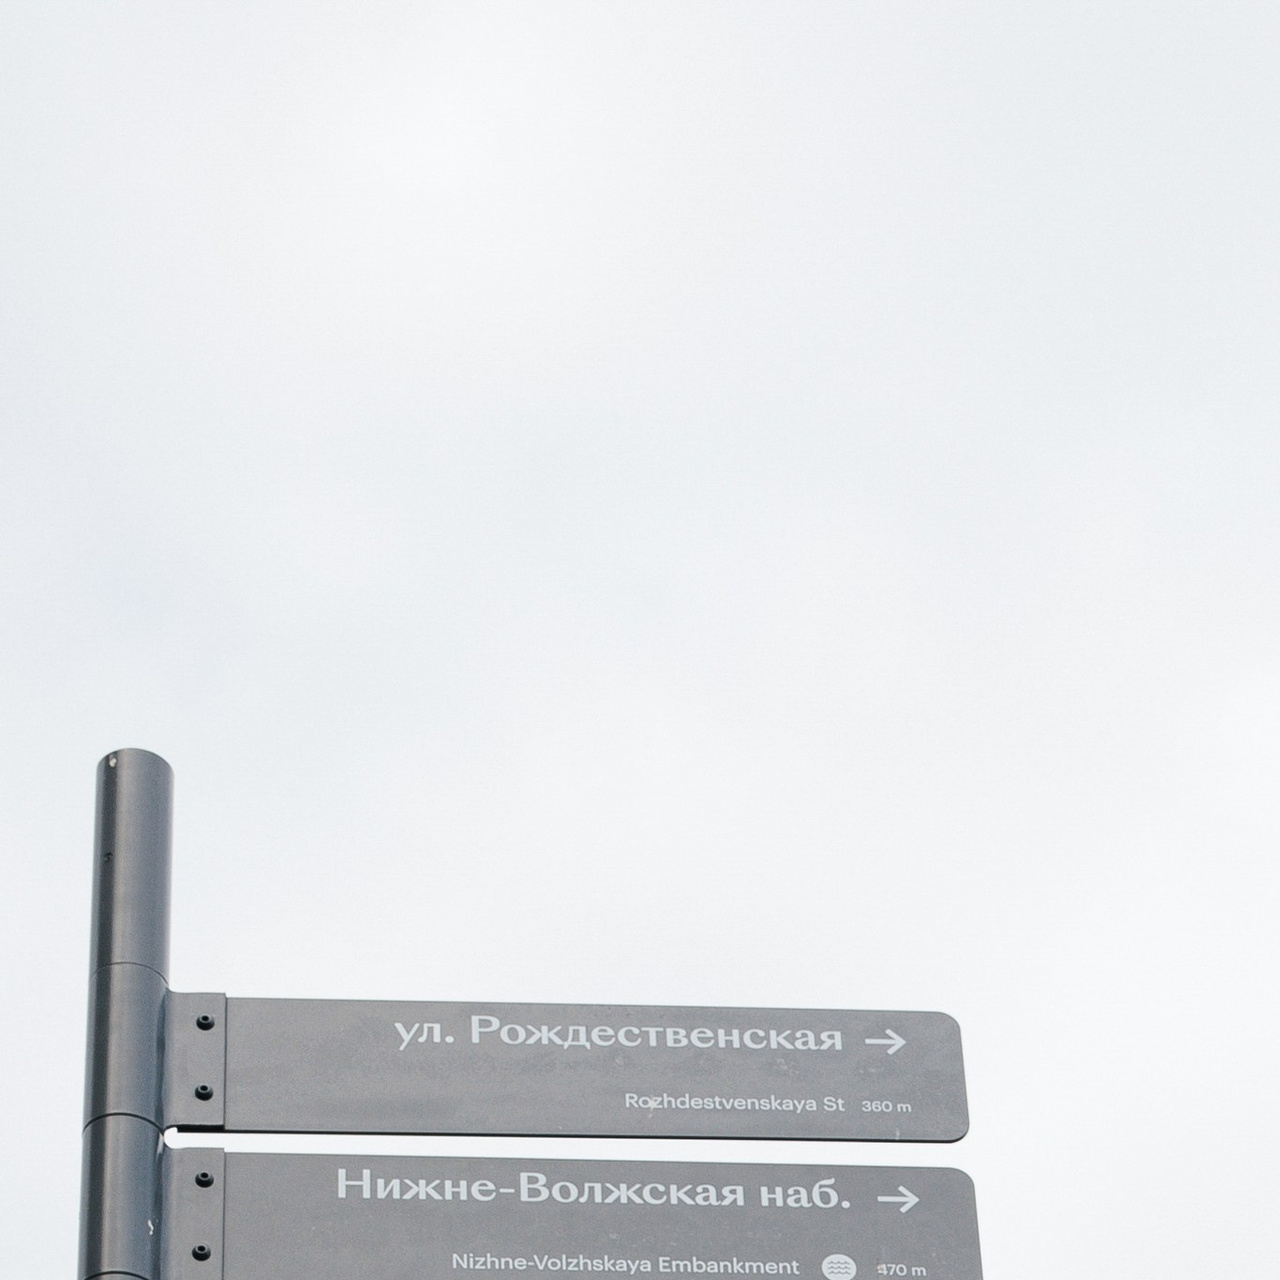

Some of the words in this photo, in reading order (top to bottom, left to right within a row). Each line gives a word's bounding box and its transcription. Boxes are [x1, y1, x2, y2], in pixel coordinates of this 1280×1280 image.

[394, 1022, 455, 1051] ул.
[470, 1015, 843, 1051] Рождественская
[625, 1092, 817, 1114] Rozhdestvenskaya
[823, 1096, 846, 1112] St
[861, 1100, 893, 1113] 360
[897, 1103, 912, 1113] m
[336, 1169, 745, 1206] Нижне-Волжская
[760, 1177, 851, 1209] наб.
[452, 1252, 652, 1275] Nizhne-Volzhskaya
[658, 1256, 800, 1275] Embankment
[911, 1266, 927, 1277] m
